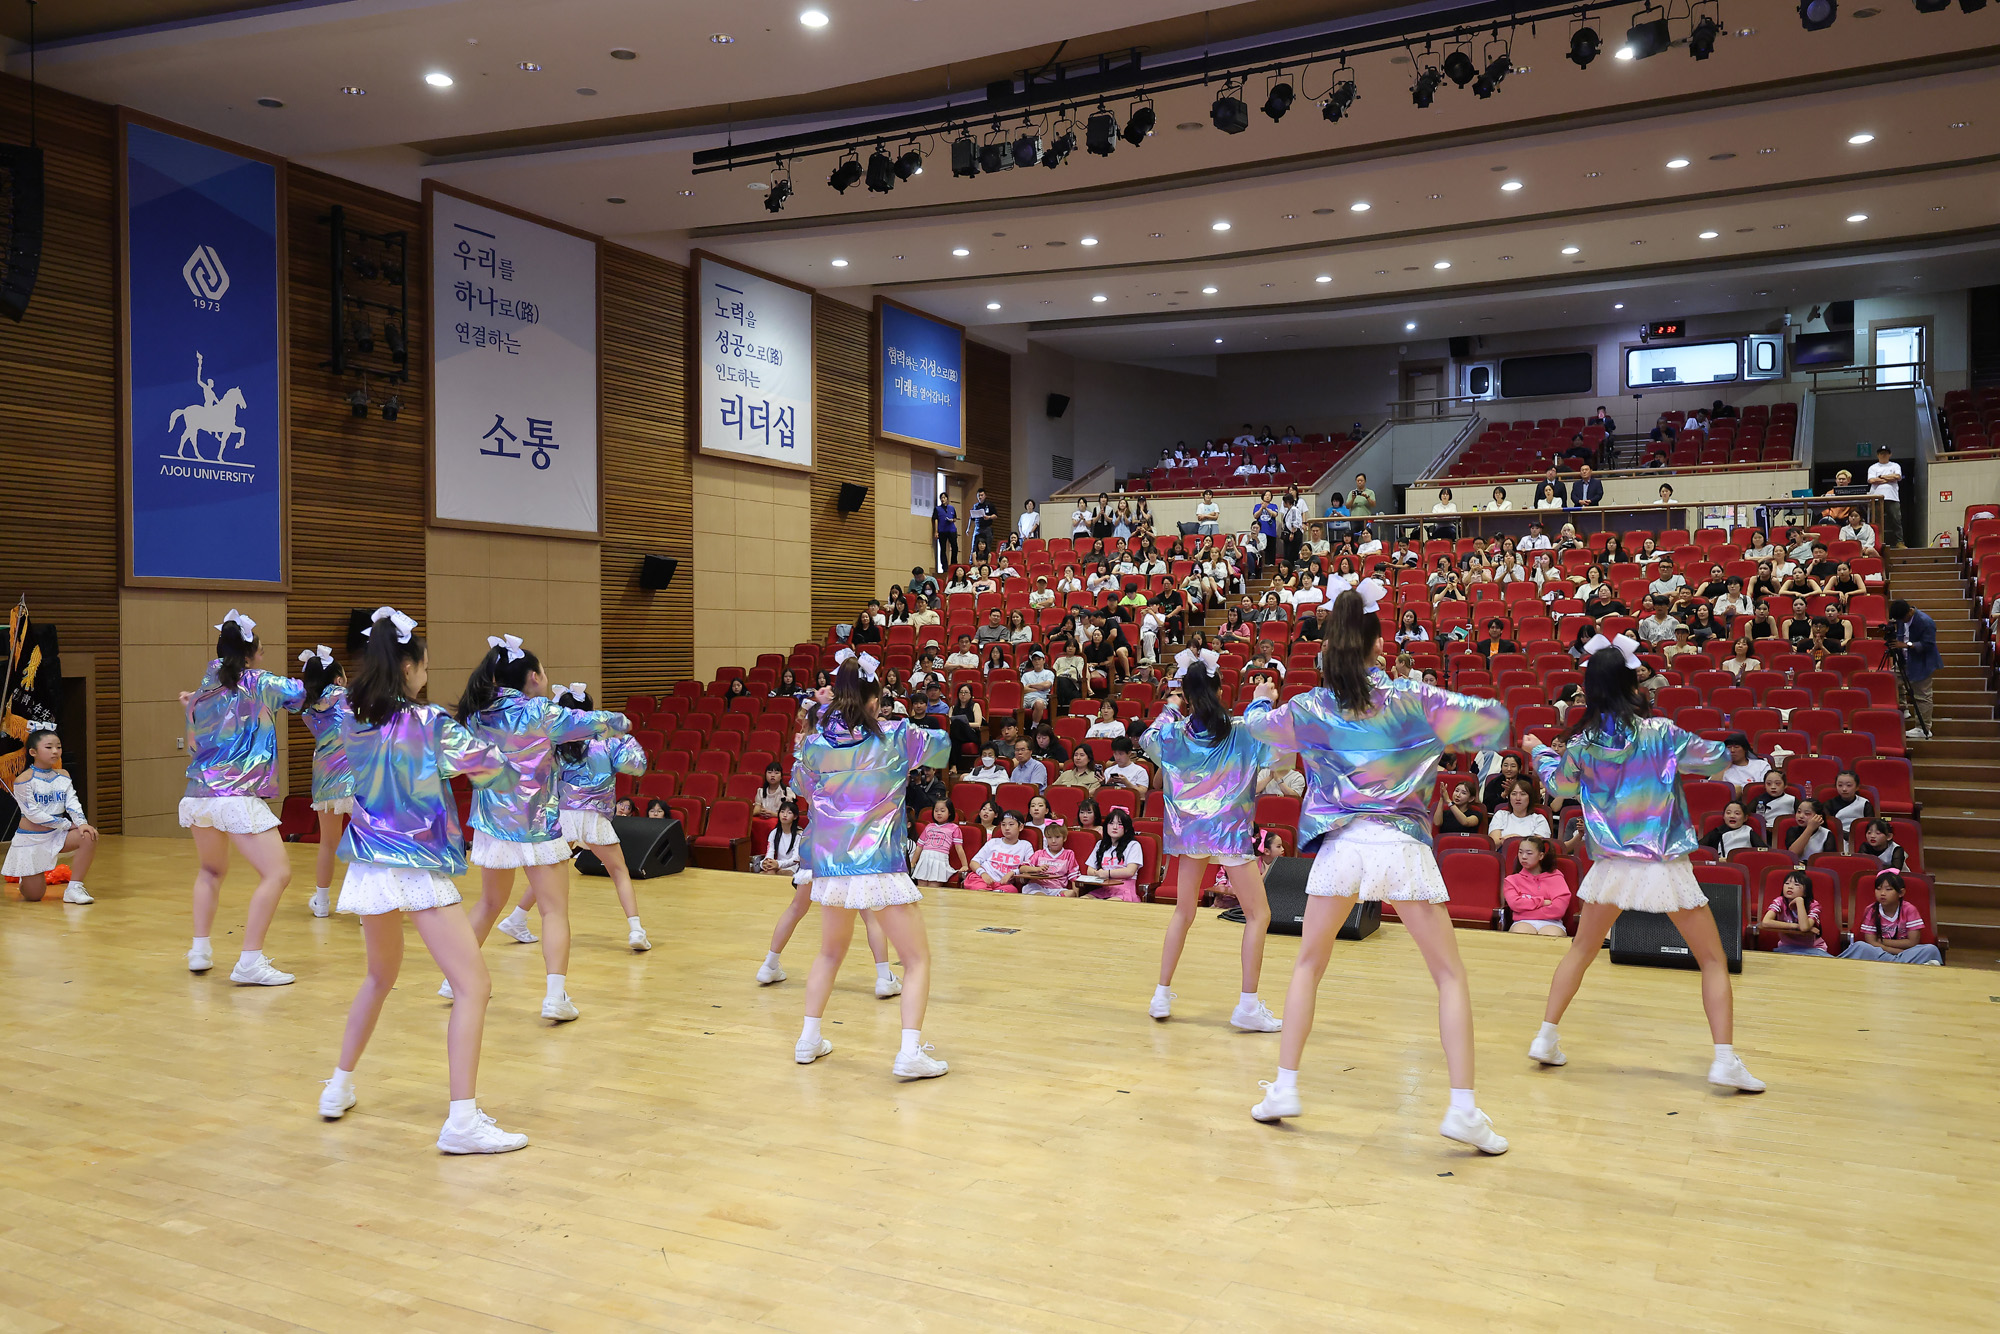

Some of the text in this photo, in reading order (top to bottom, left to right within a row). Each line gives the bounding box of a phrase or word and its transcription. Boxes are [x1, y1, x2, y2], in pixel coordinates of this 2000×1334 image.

[453, 239, 515, 282] 우리를
[193, 298, 221, 312] 1973
[453, 280, 540, 325] 하나로(路)
[714, 297, 757, 329] 노력을
[455, 321, 522, 355] 연결하는
[715, 329, 783, 367] 성공으로(路)
[887, 346, 919, 372] 협력하는
[715, 363, 761, 389] 인도하는
[894, 376, 952, 407] 미래를 열어갑니다.
[720, 394, 795, 449] 리더십
[479, 413, 560, 470] 소통
[159, 464, 255, 484] AJOU UNIVERSITY
[991, 851, 1021, 865] LET'S
